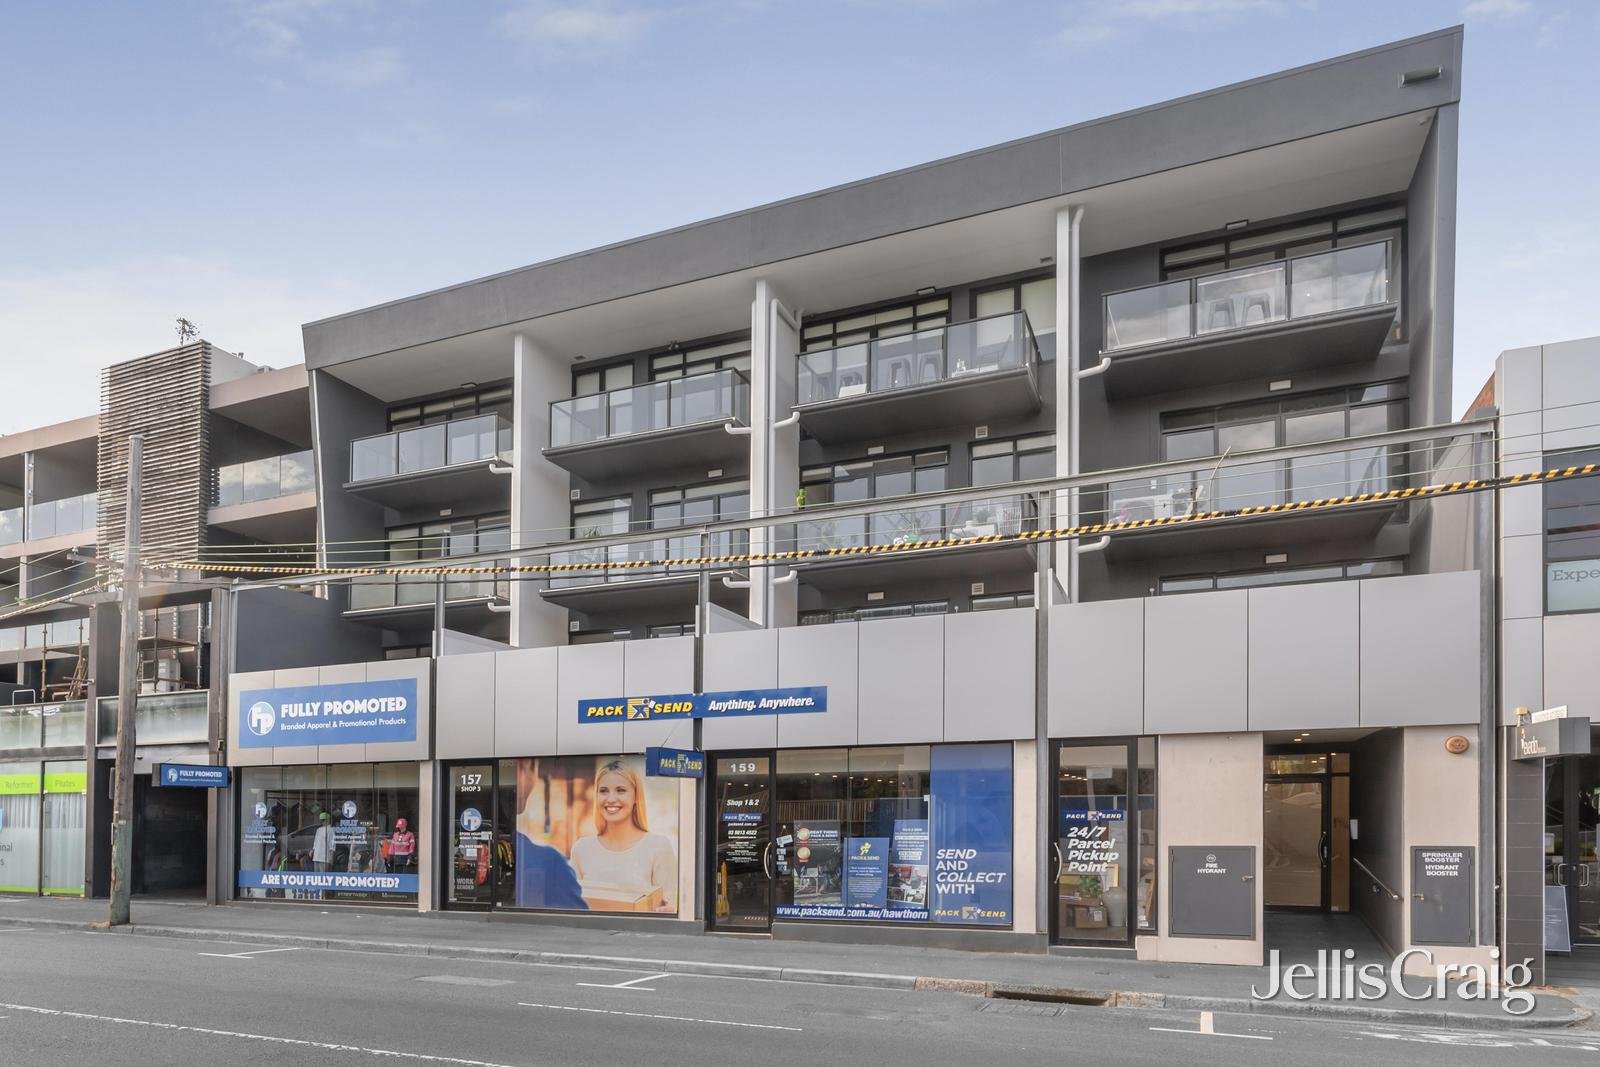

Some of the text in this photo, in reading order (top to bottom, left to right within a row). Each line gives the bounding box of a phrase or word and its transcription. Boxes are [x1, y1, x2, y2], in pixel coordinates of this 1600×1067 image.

[281, 697, 407, 718] FULLY PROMOTED
[587, 702, 693, 717] PACK SEND
[708, 697, 815, 712] Anything. Anywhere.
[281, 723, 305, 731] Branded
[307, 721, 331, 730] Apparel
[339, 719, 378, 728] Promotional
[379, 717, 407, 726] Products
[660, 758, 703, 770] PACK SEND
[731, 763, 756, 773] 159
[461, 774, 482, 785] 157
[727, 799, 743, 807] Shop
[1067, 826, 1107, 839] 24/7
[1068, 838, 1116, 849] Parcel
[936, 849, 977, 860] SEND
[1068, 850, 1119, 863] Pickup
[935, 860, 968, 871] AND
[1068, 861, 1108, 872] Point
[261, 874, 400, 888] ARE YOU FULLY PROMOTED?
[936, 872, 1007, 883] COLLECT
[935, 883, 975, 894] WITH
[776, 906, 929, 919] www.packsend.com.au/hawthorn
[935, 909, 960, 917] PACK
